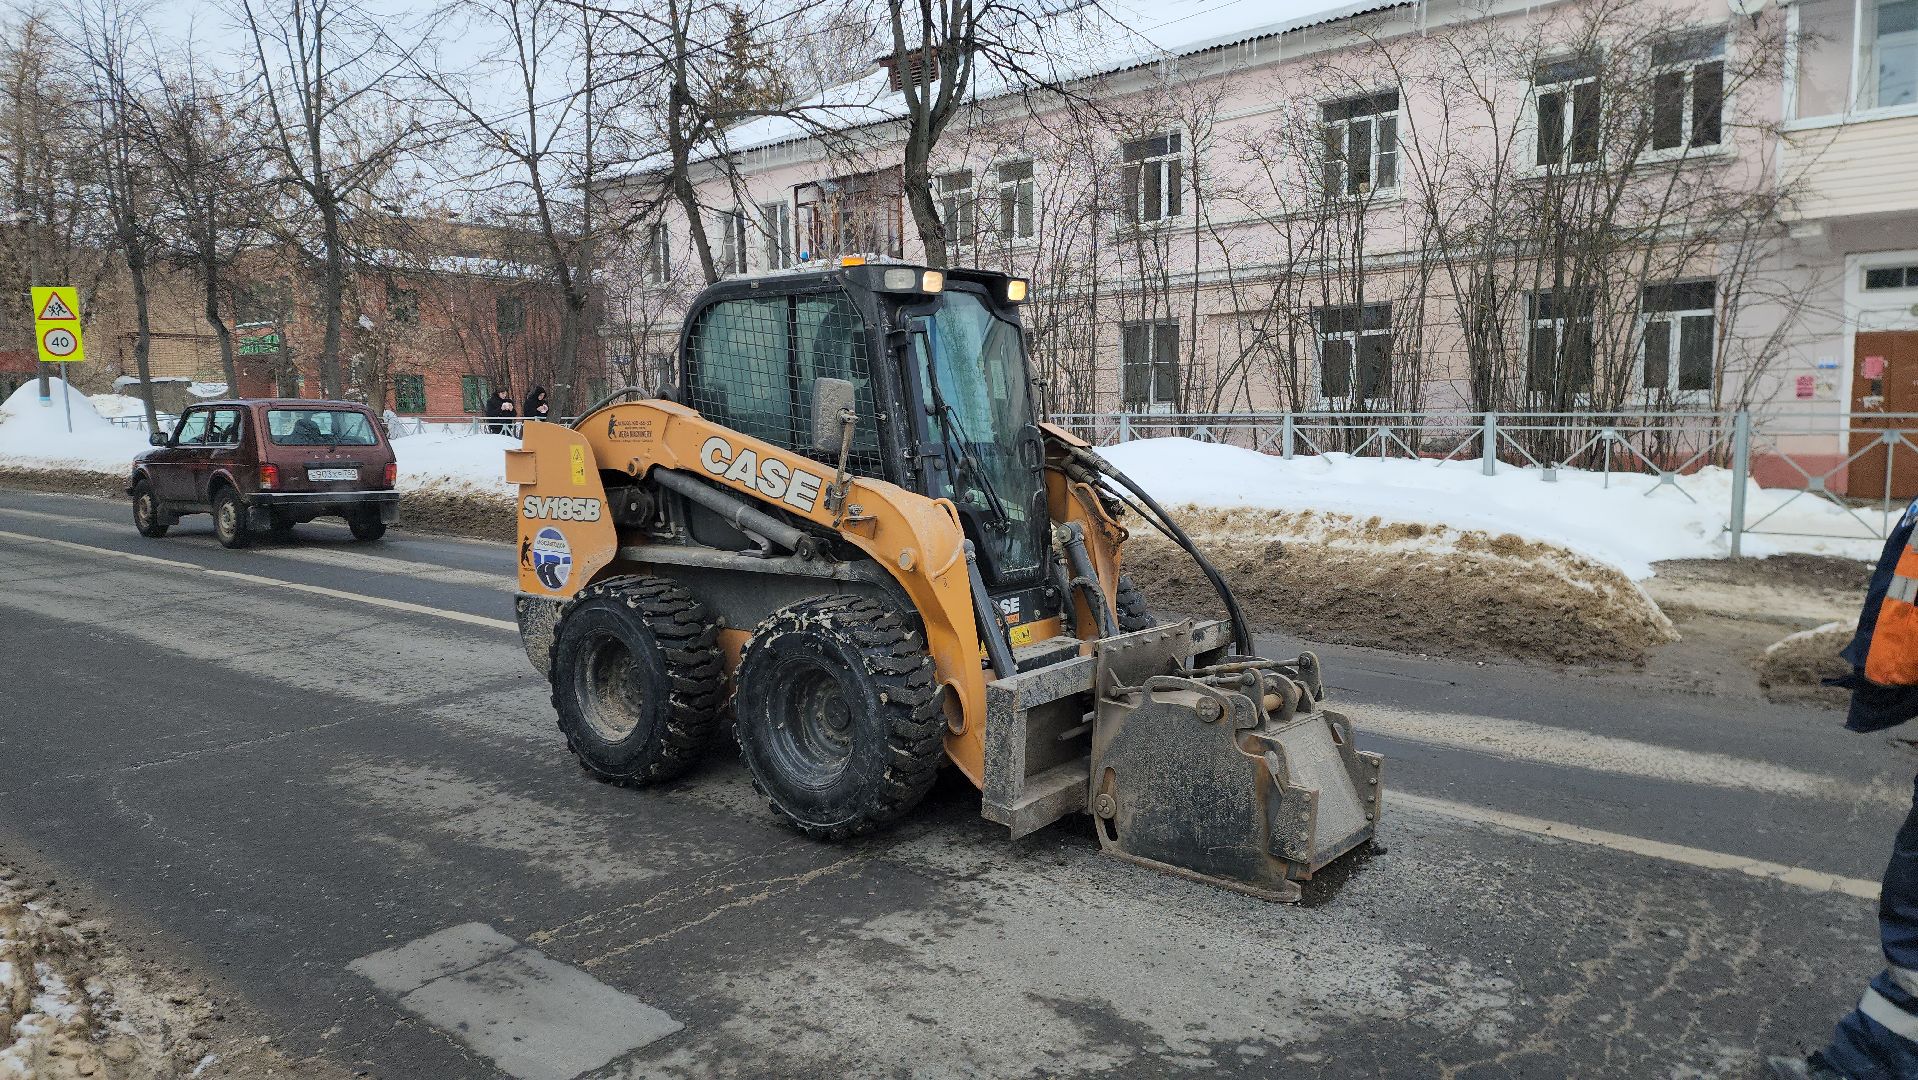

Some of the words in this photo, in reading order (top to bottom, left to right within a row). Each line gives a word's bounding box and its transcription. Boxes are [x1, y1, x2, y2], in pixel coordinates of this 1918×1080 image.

[51, 336, 70, 348] 40
[701, 436, 823, 513] CASE
[523, 495, 601, 522] SV185B
[993, 597, 1020, 615] SE
